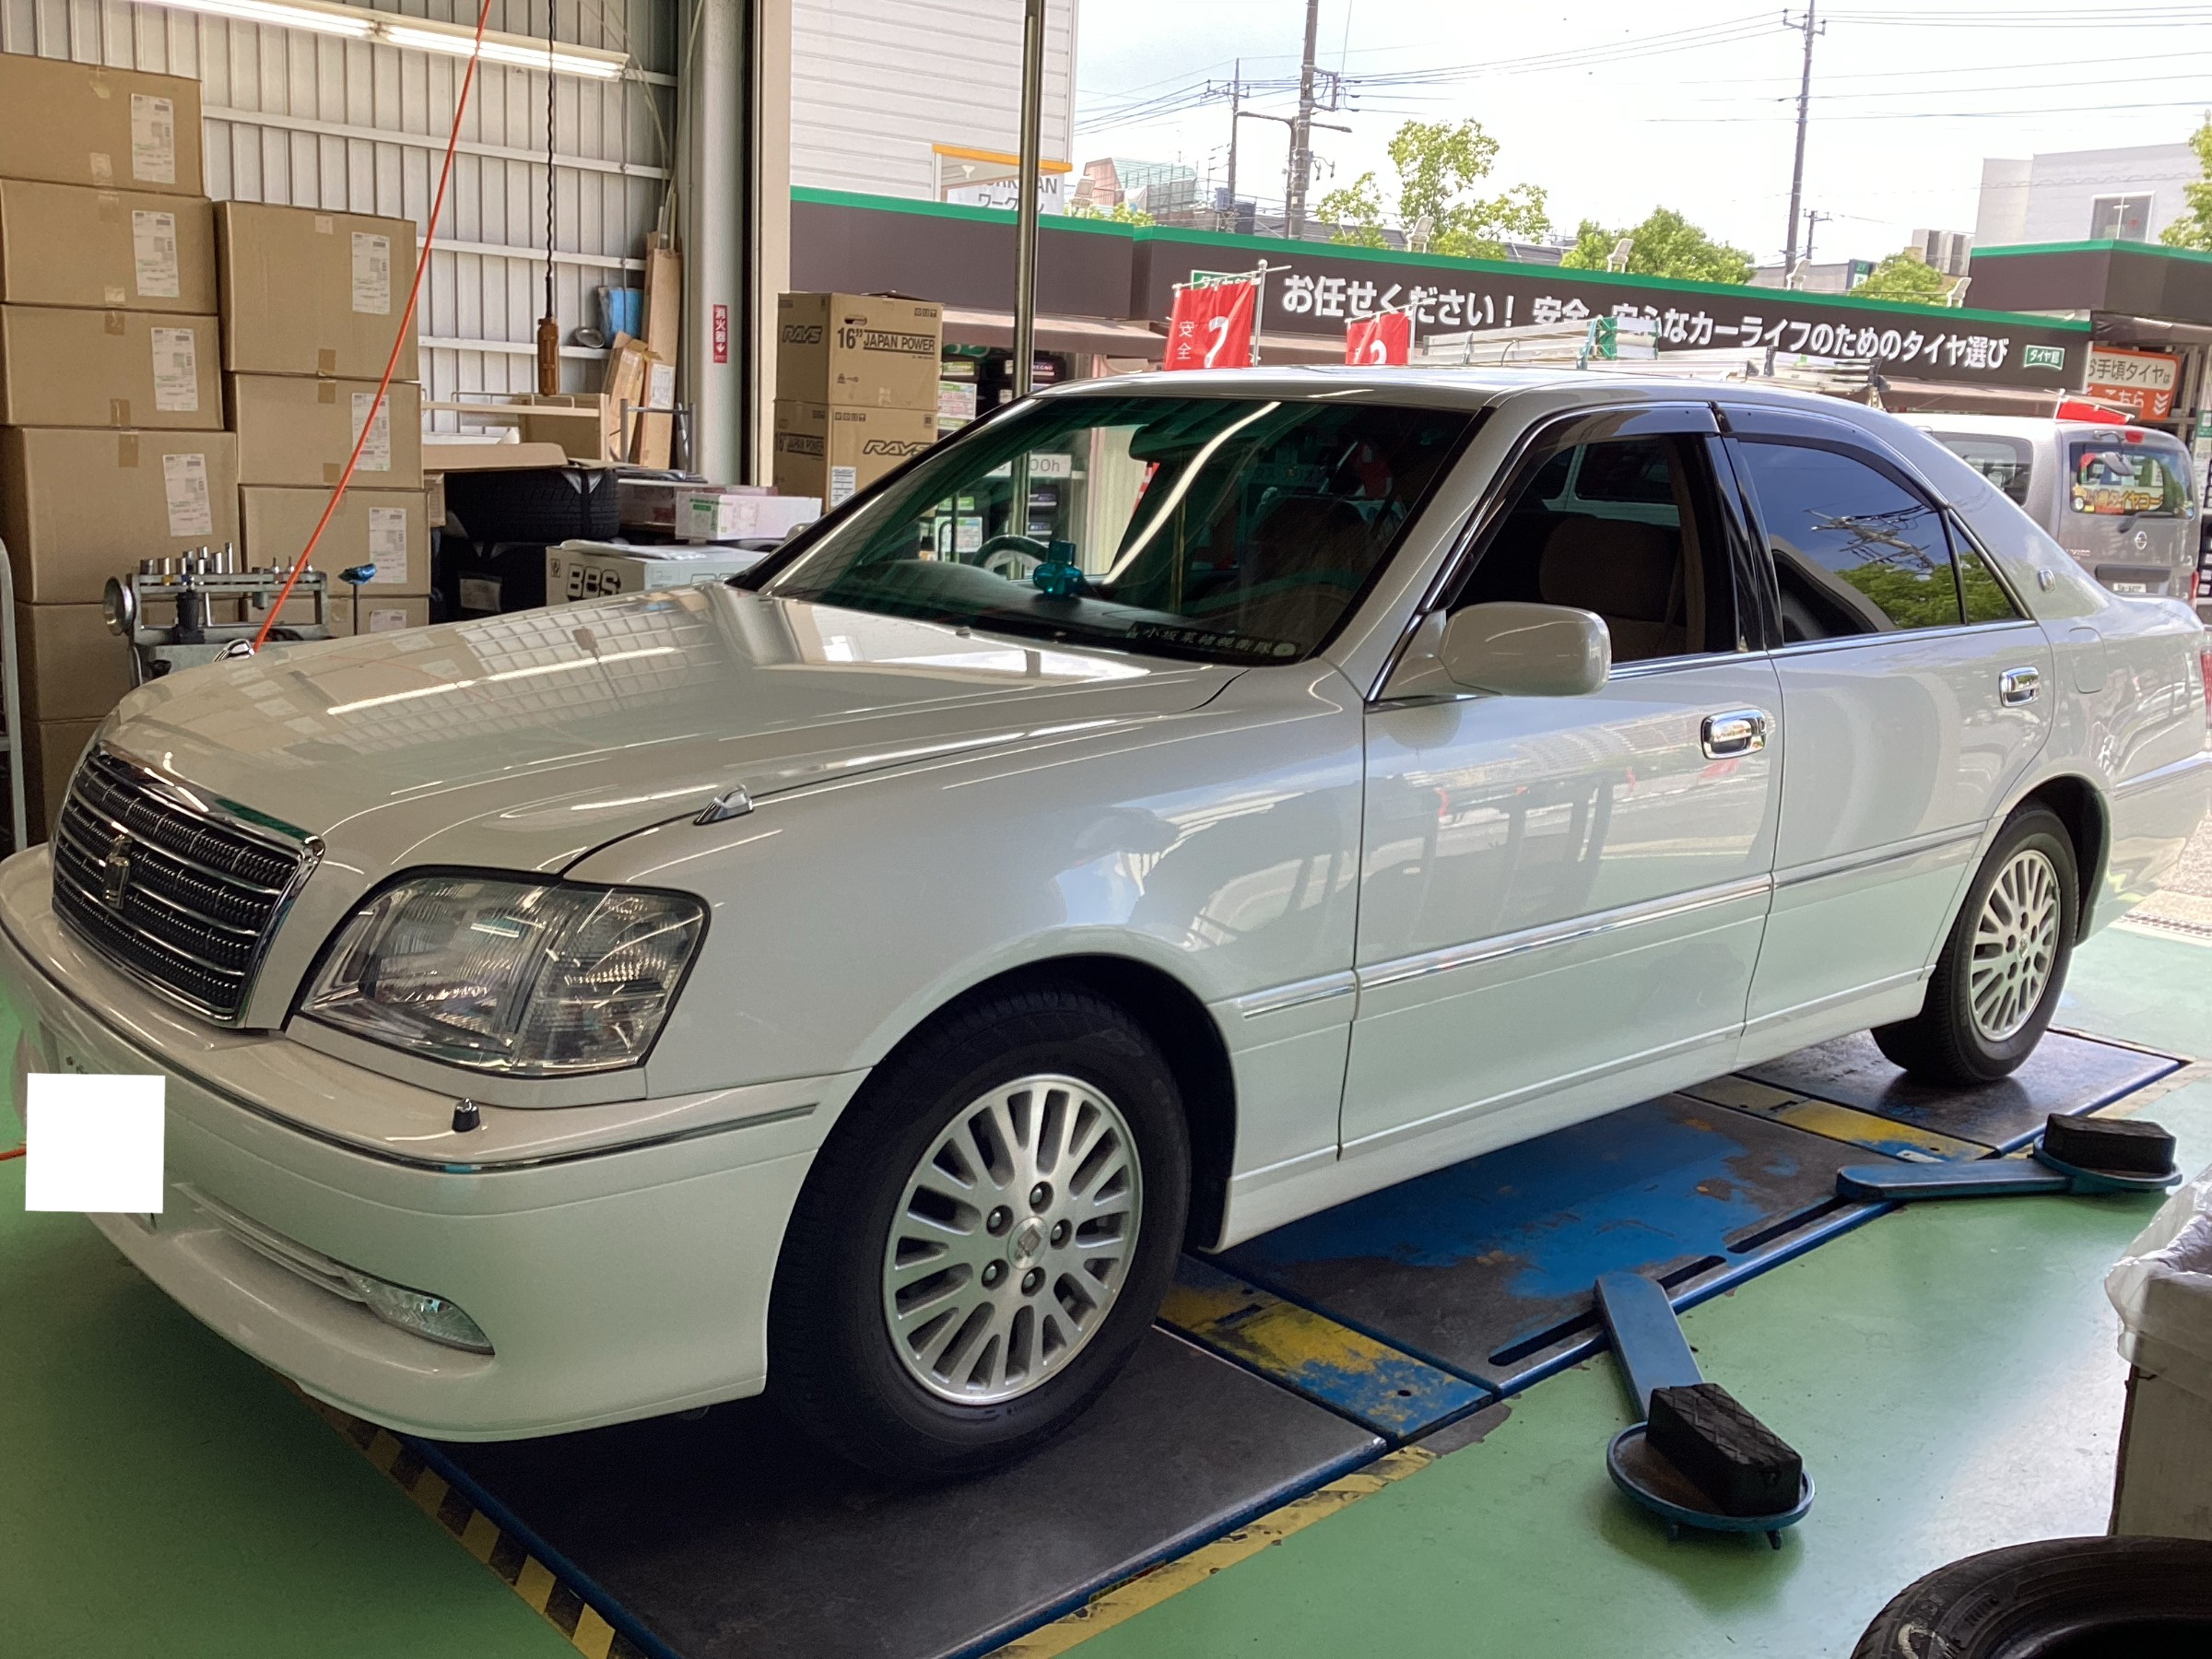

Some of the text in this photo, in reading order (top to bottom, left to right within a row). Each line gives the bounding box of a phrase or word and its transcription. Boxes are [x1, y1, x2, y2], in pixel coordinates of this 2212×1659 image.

[782, 324, 823, 345] RAYS
[863, 334, 899, 352] JAPAN
[900, 336, 935, 352] POWER
[1176, 321, 1195, 359] 安全
[567, 562, 621, 602] BBS
